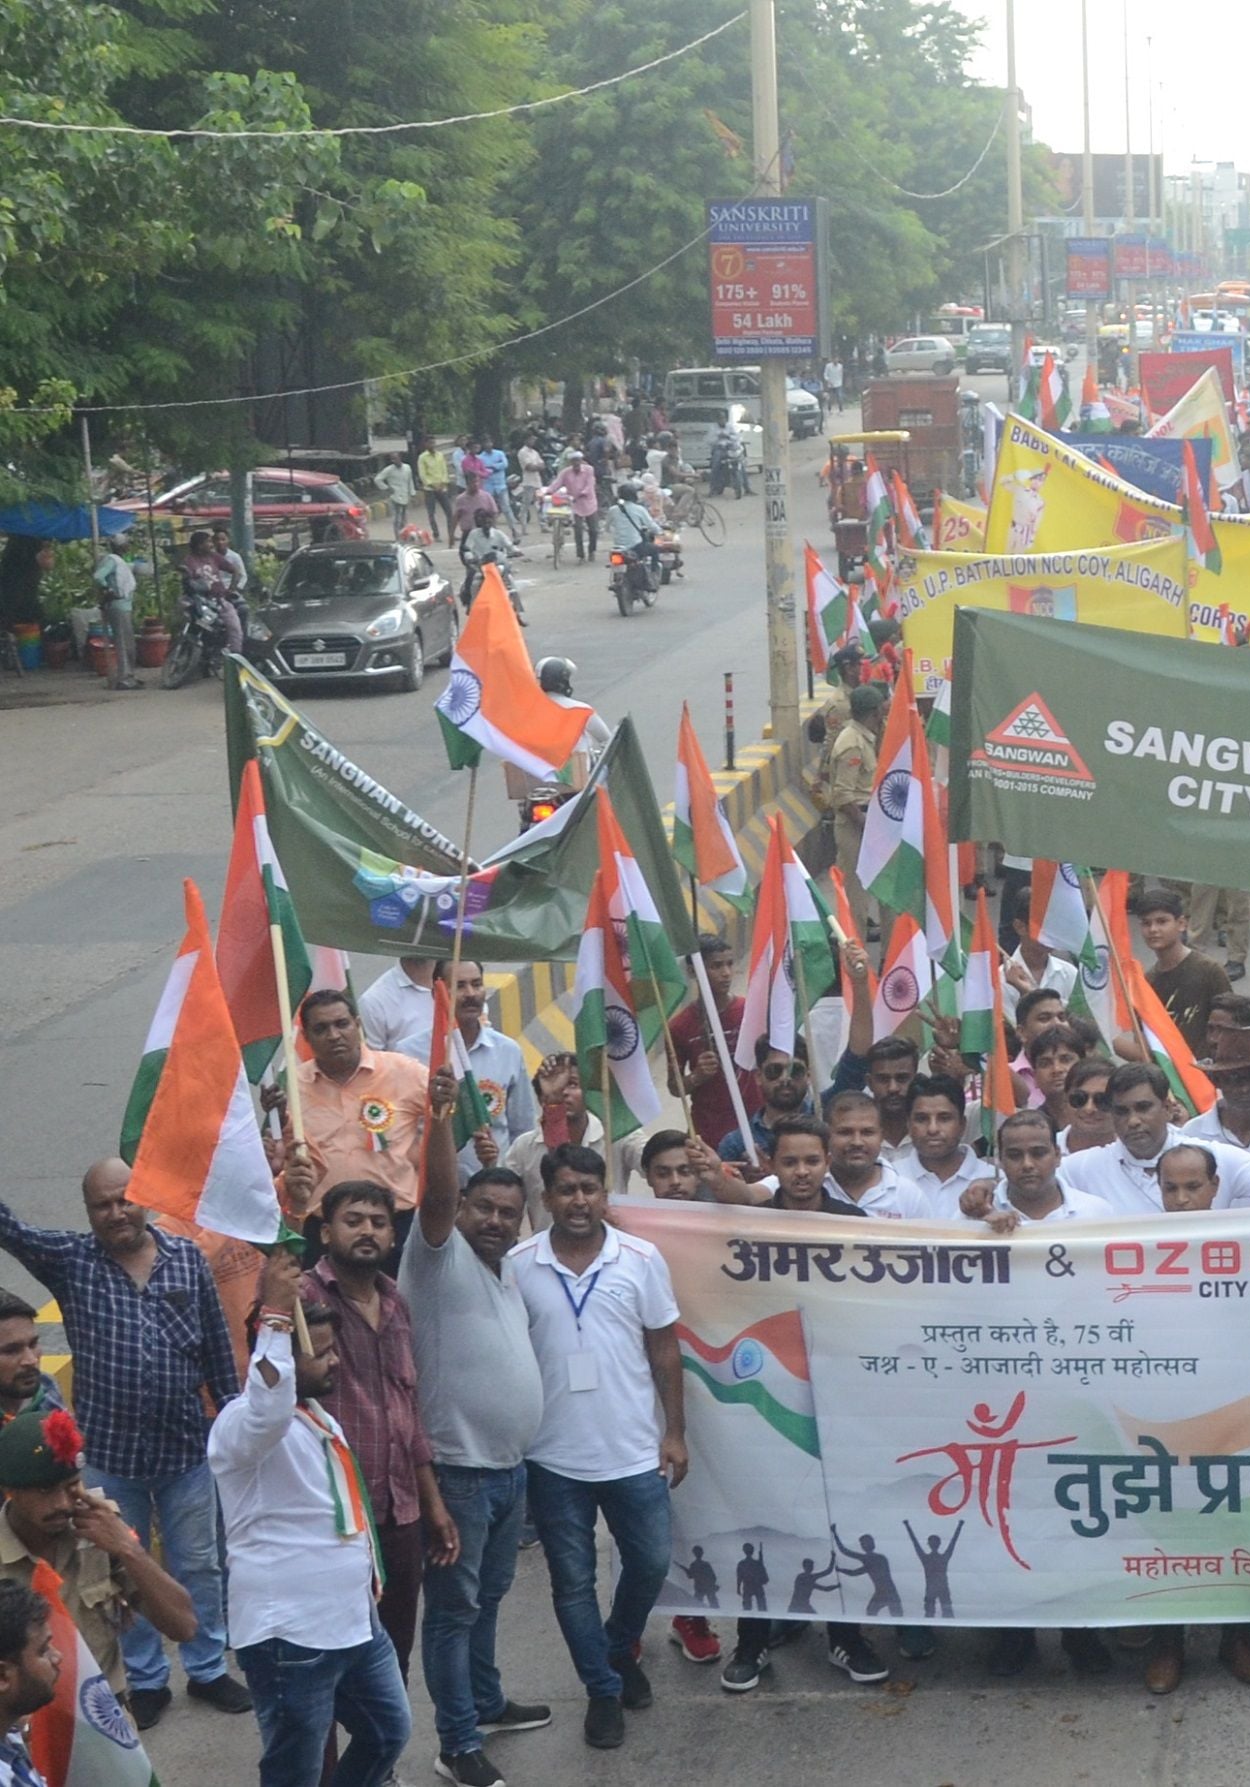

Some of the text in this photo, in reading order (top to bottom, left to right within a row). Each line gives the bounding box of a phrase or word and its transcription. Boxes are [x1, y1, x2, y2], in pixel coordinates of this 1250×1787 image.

[710, 206, 808, 221] SANSKRITI
[719, 222, 800, 232] UNIVERSITY
[717, 284, 757, 299] 175+
[772, 284, 806, 299] 91%
[733, 313, 793, 328] 54 Lakh
[943, 517, 970, 543] 25
[924, 571, 952, 598] U.P.
[955, 556, 1037, 586] BATTALION
[1042, 556, 1073, 574] NCC
[1078, 555, 1112, 581] COY,
[1115, 561, 1184, 607] ALIGARH
[984, 742, 1068, 766] SANGWAN
[300, 731, 402, 814] SANGWAN
[1040, 785, 1094, 801] COMPANY
[1045, 1243, 1076, 1278] &
[1199, 1281, 1249, 1299] CITY
[921, 1324, 981, 1353] प्रस्तुत
[990, 1318, 1037, 1344] करते
[1074, 1324, 1101, 1345] 75
[1107, 1318, 1135, 1344] वीं
[923, 1356, 939, 1378] ए
[960, 1354, 1042, 1376] आजादी
[1051, 1357, 1105, 1385] अमृत
[1112, 1350, 1199, 1376] महोत्सव
[1047, 1435, 1178, 1538] तुझे
[1123, 1547, 1225, 1579] महोत्सव
